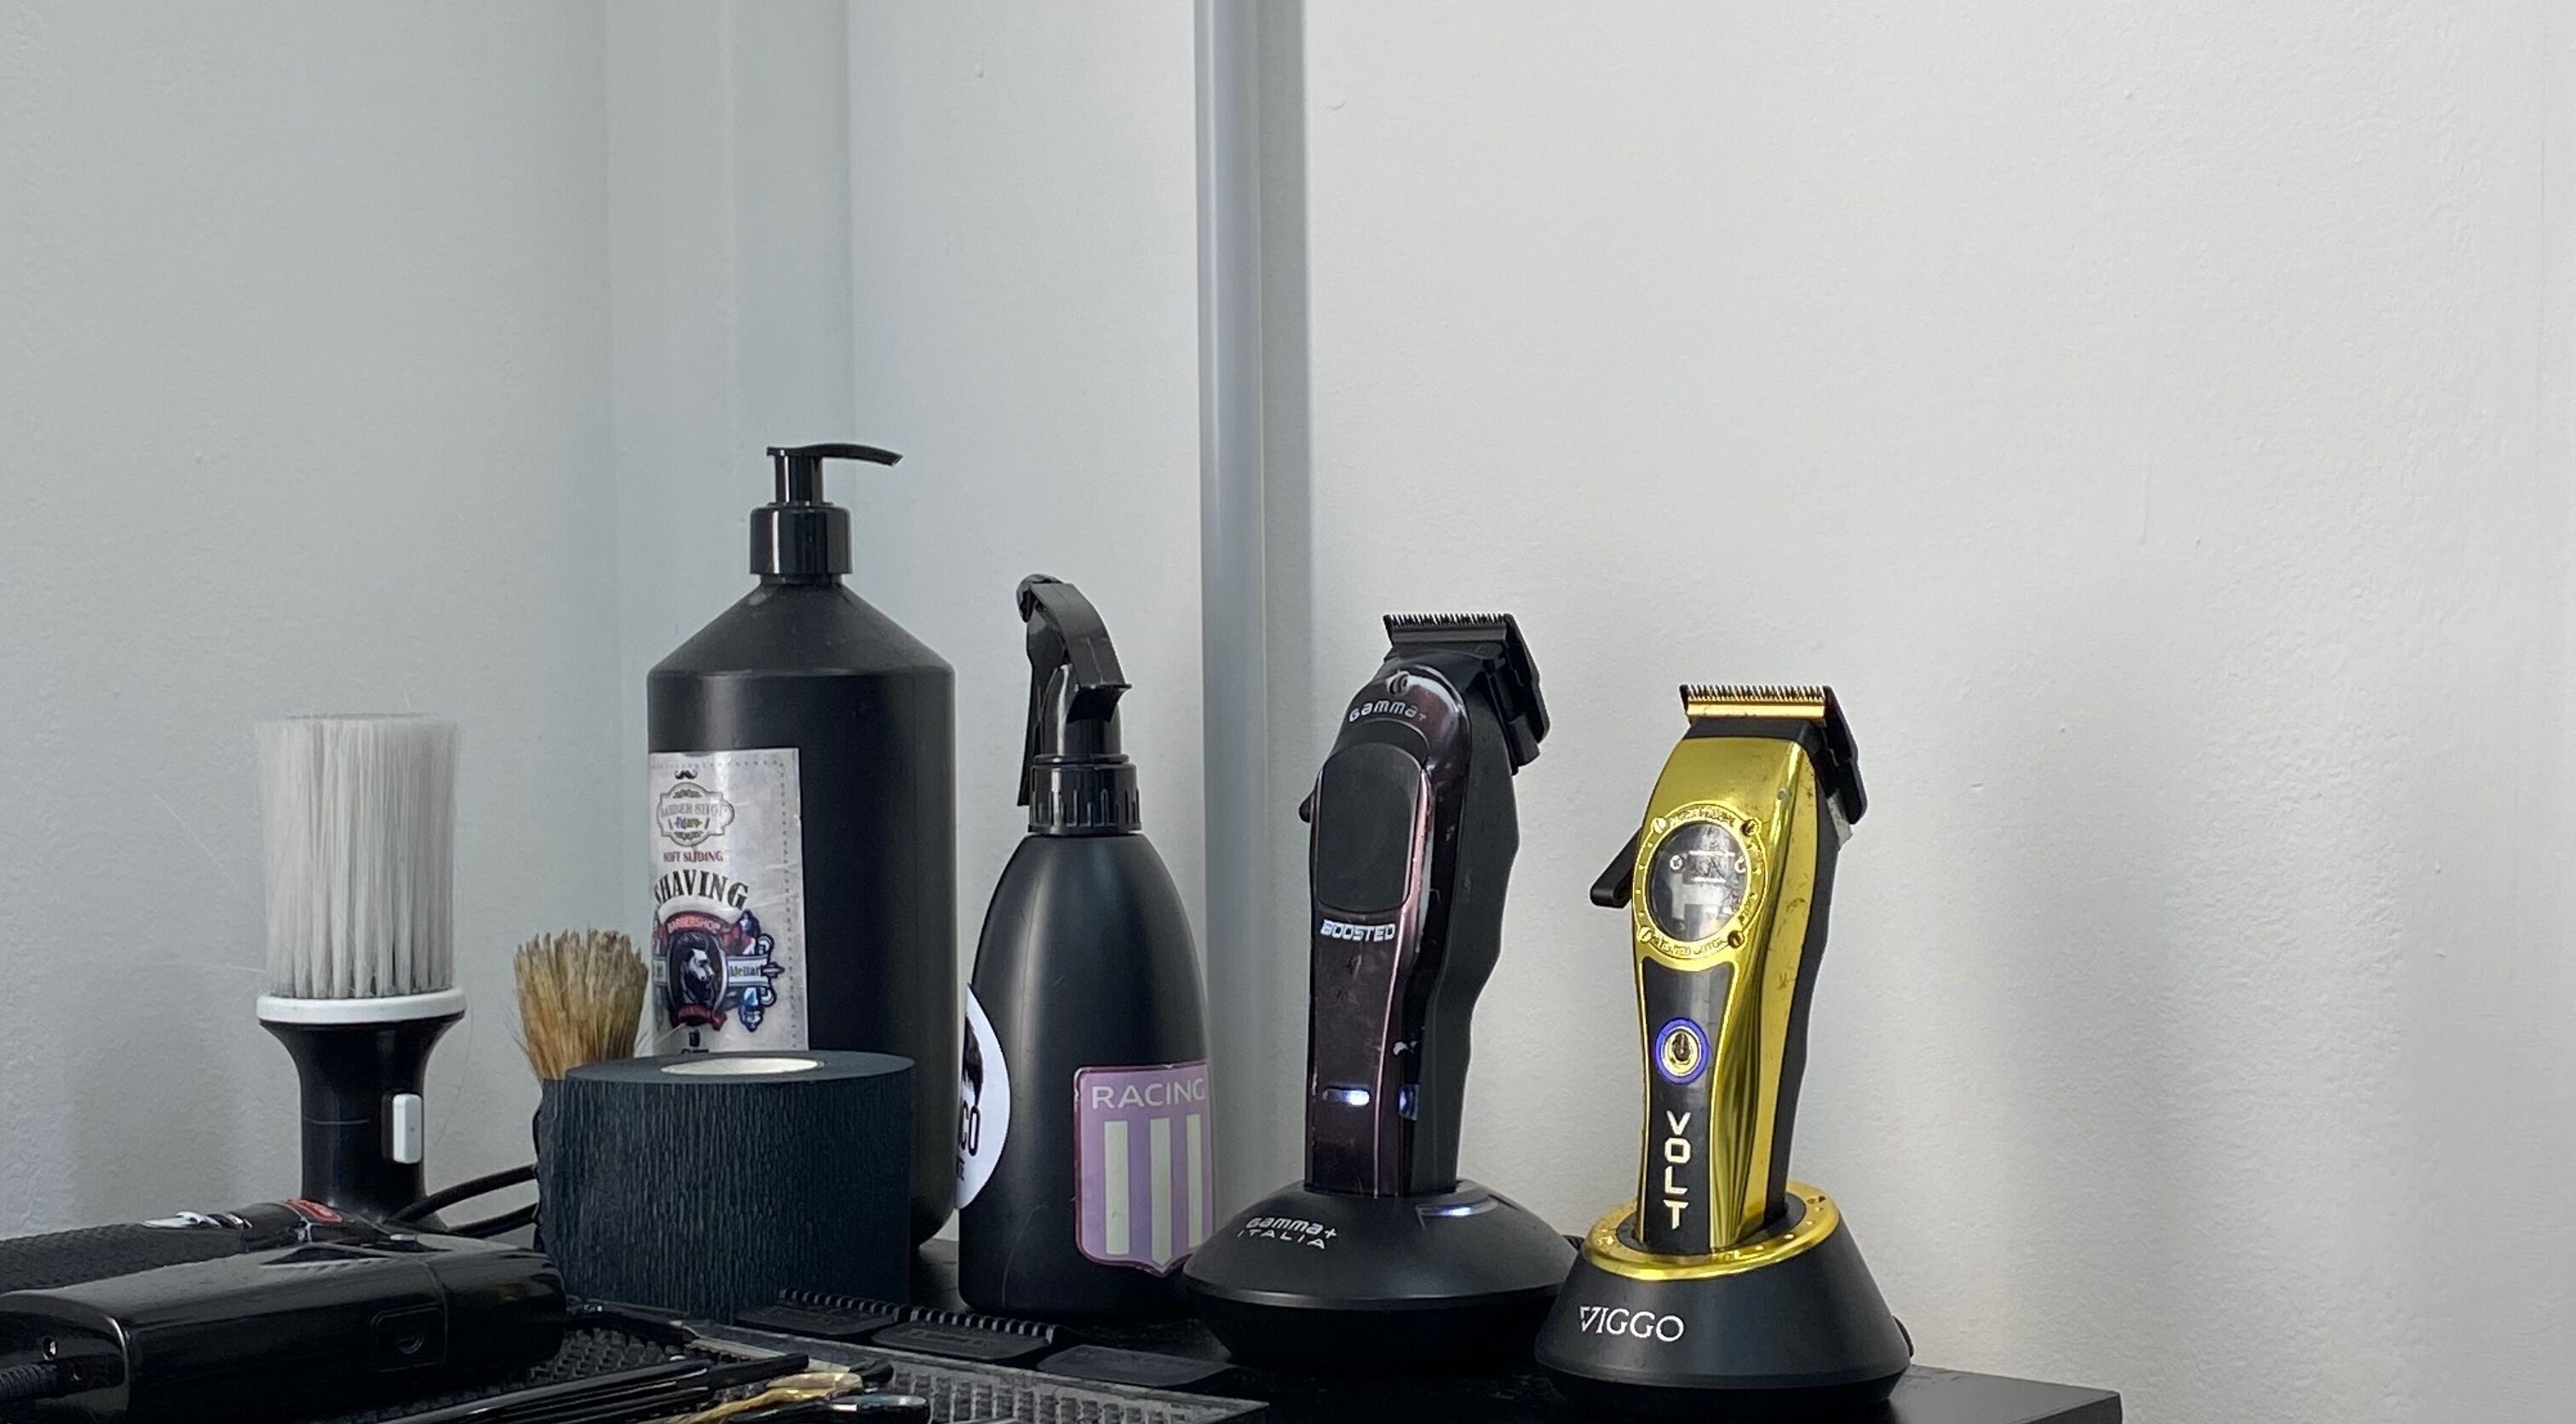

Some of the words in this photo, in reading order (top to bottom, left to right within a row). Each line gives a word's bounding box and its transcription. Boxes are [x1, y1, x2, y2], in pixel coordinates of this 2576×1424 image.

[682, 851, 724, 863] SLIDING
[654, 869, 749, 910] SHAVING
[1320, 919, 1396, 942] BOOSTED
[1091, 1077, 1206, 1110] RACING
[1663, 1110, 1692, 1230] VOLT
[1237, 1229, 1325, 1250] ITALIA
[1579, 1305, 1685, 1343] VIGGO
